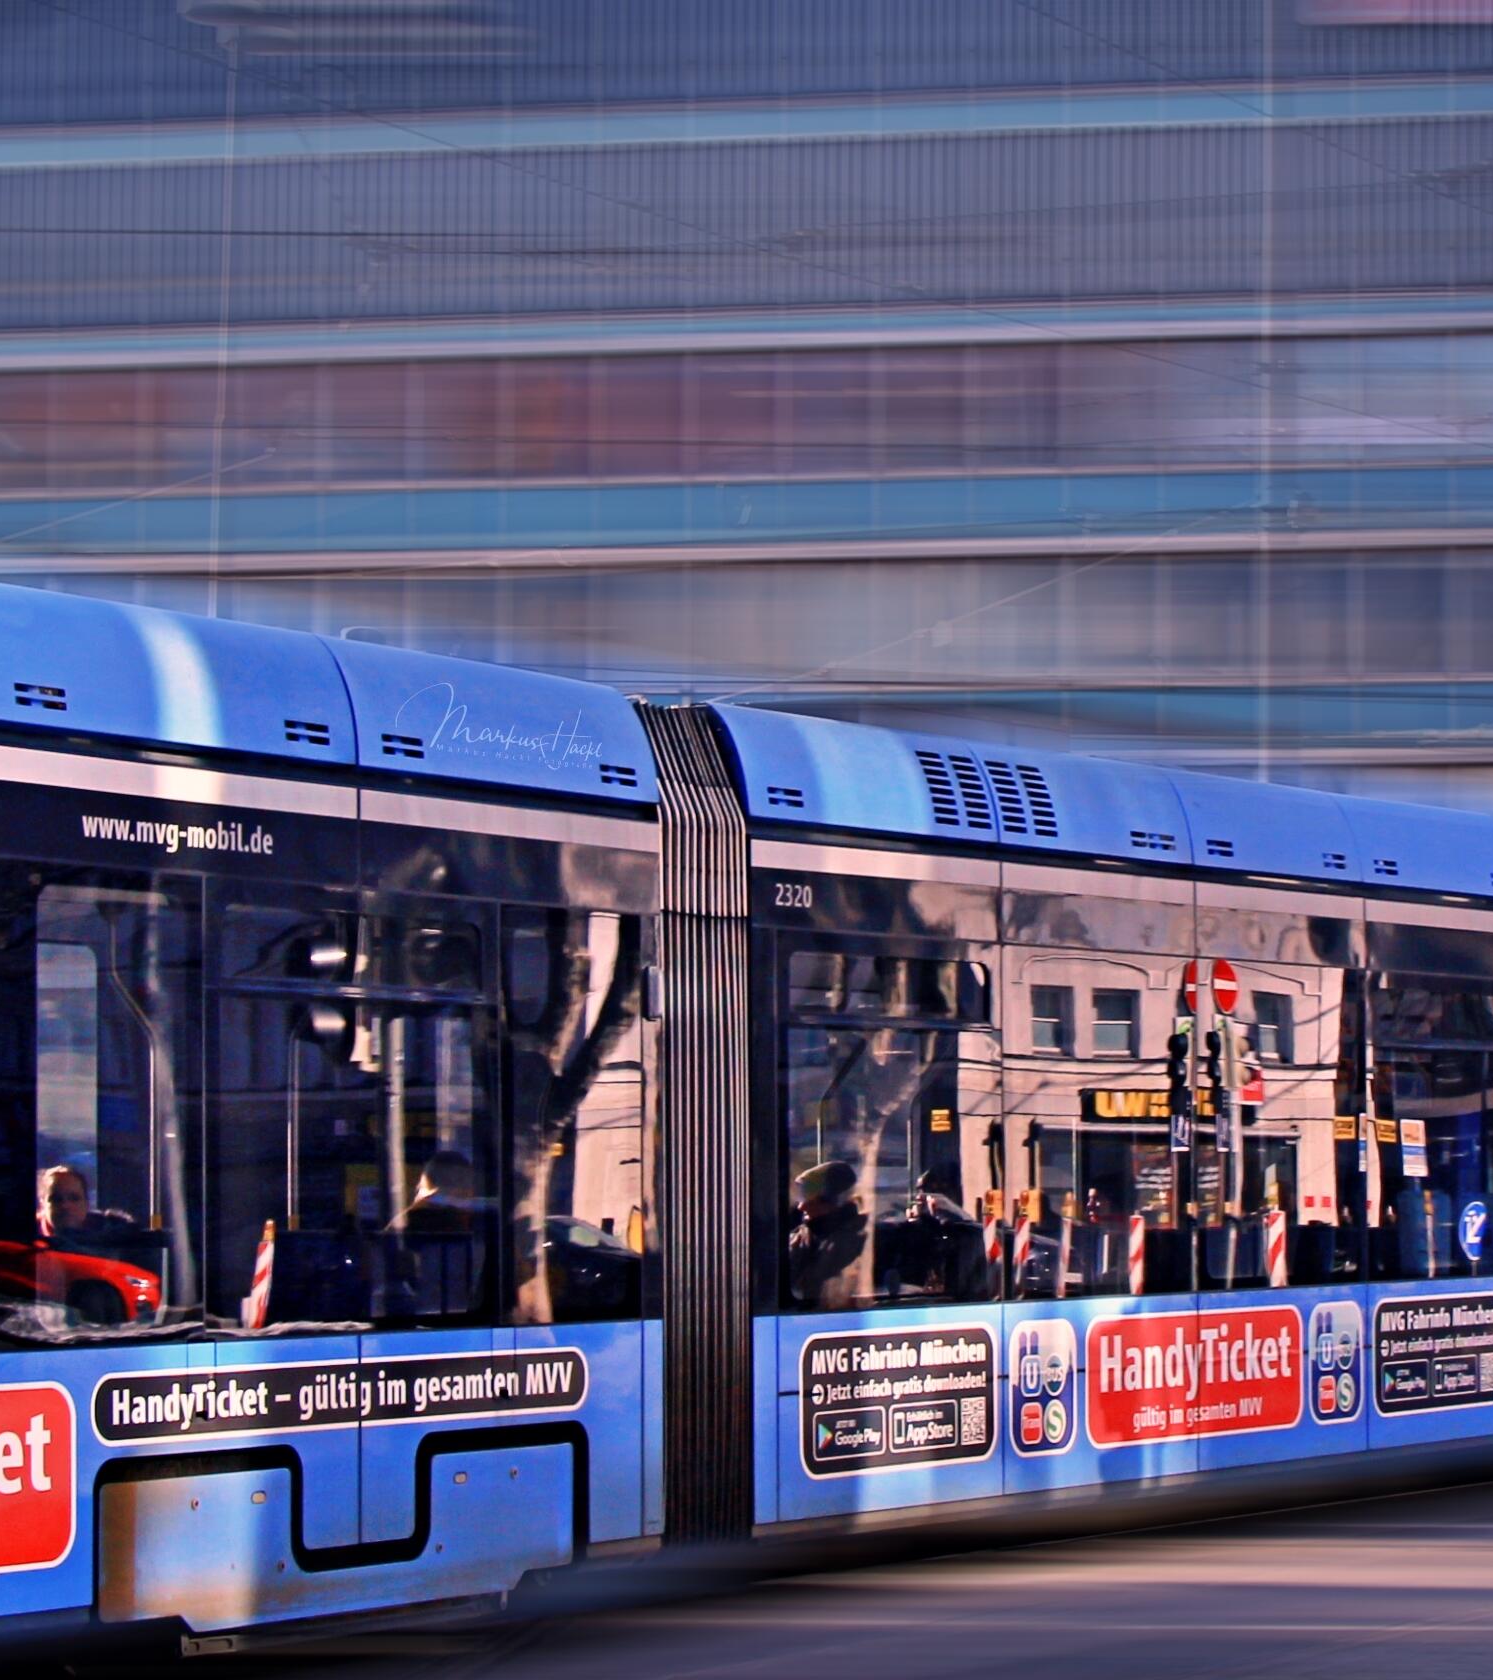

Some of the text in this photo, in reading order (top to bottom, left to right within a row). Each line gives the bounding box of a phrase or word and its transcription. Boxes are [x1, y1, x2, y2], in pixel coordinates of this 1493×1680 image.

[81, 813, 274, 856] www.mvg-mobil.de
[775, 883, 812, 908] 2320
[1407, 1306, 1451, 1329] Fahrinfo
[812, 1337, 986, 1375] MVG Fahrinfo München
[1099, 1322, 1292, 1402] HandyTicket
[111, 1374, 268, 1430] HandyTicket
[299, 1373, 371, 1419] gültig
[377, 1371, 407, 1402] im
[413, 1370, 519, 1411] gesamten
[525, 1361, 574, 1396] MVV
[826, 1371, 987, 1405] Jetzt einfach gratis downloaden!
[1132, 1396, 1263, 1433] gültig im gesamten MVV
[835, 1427, 882, 1448] Google Play
[906, 1421, 954, 1446] App Store
